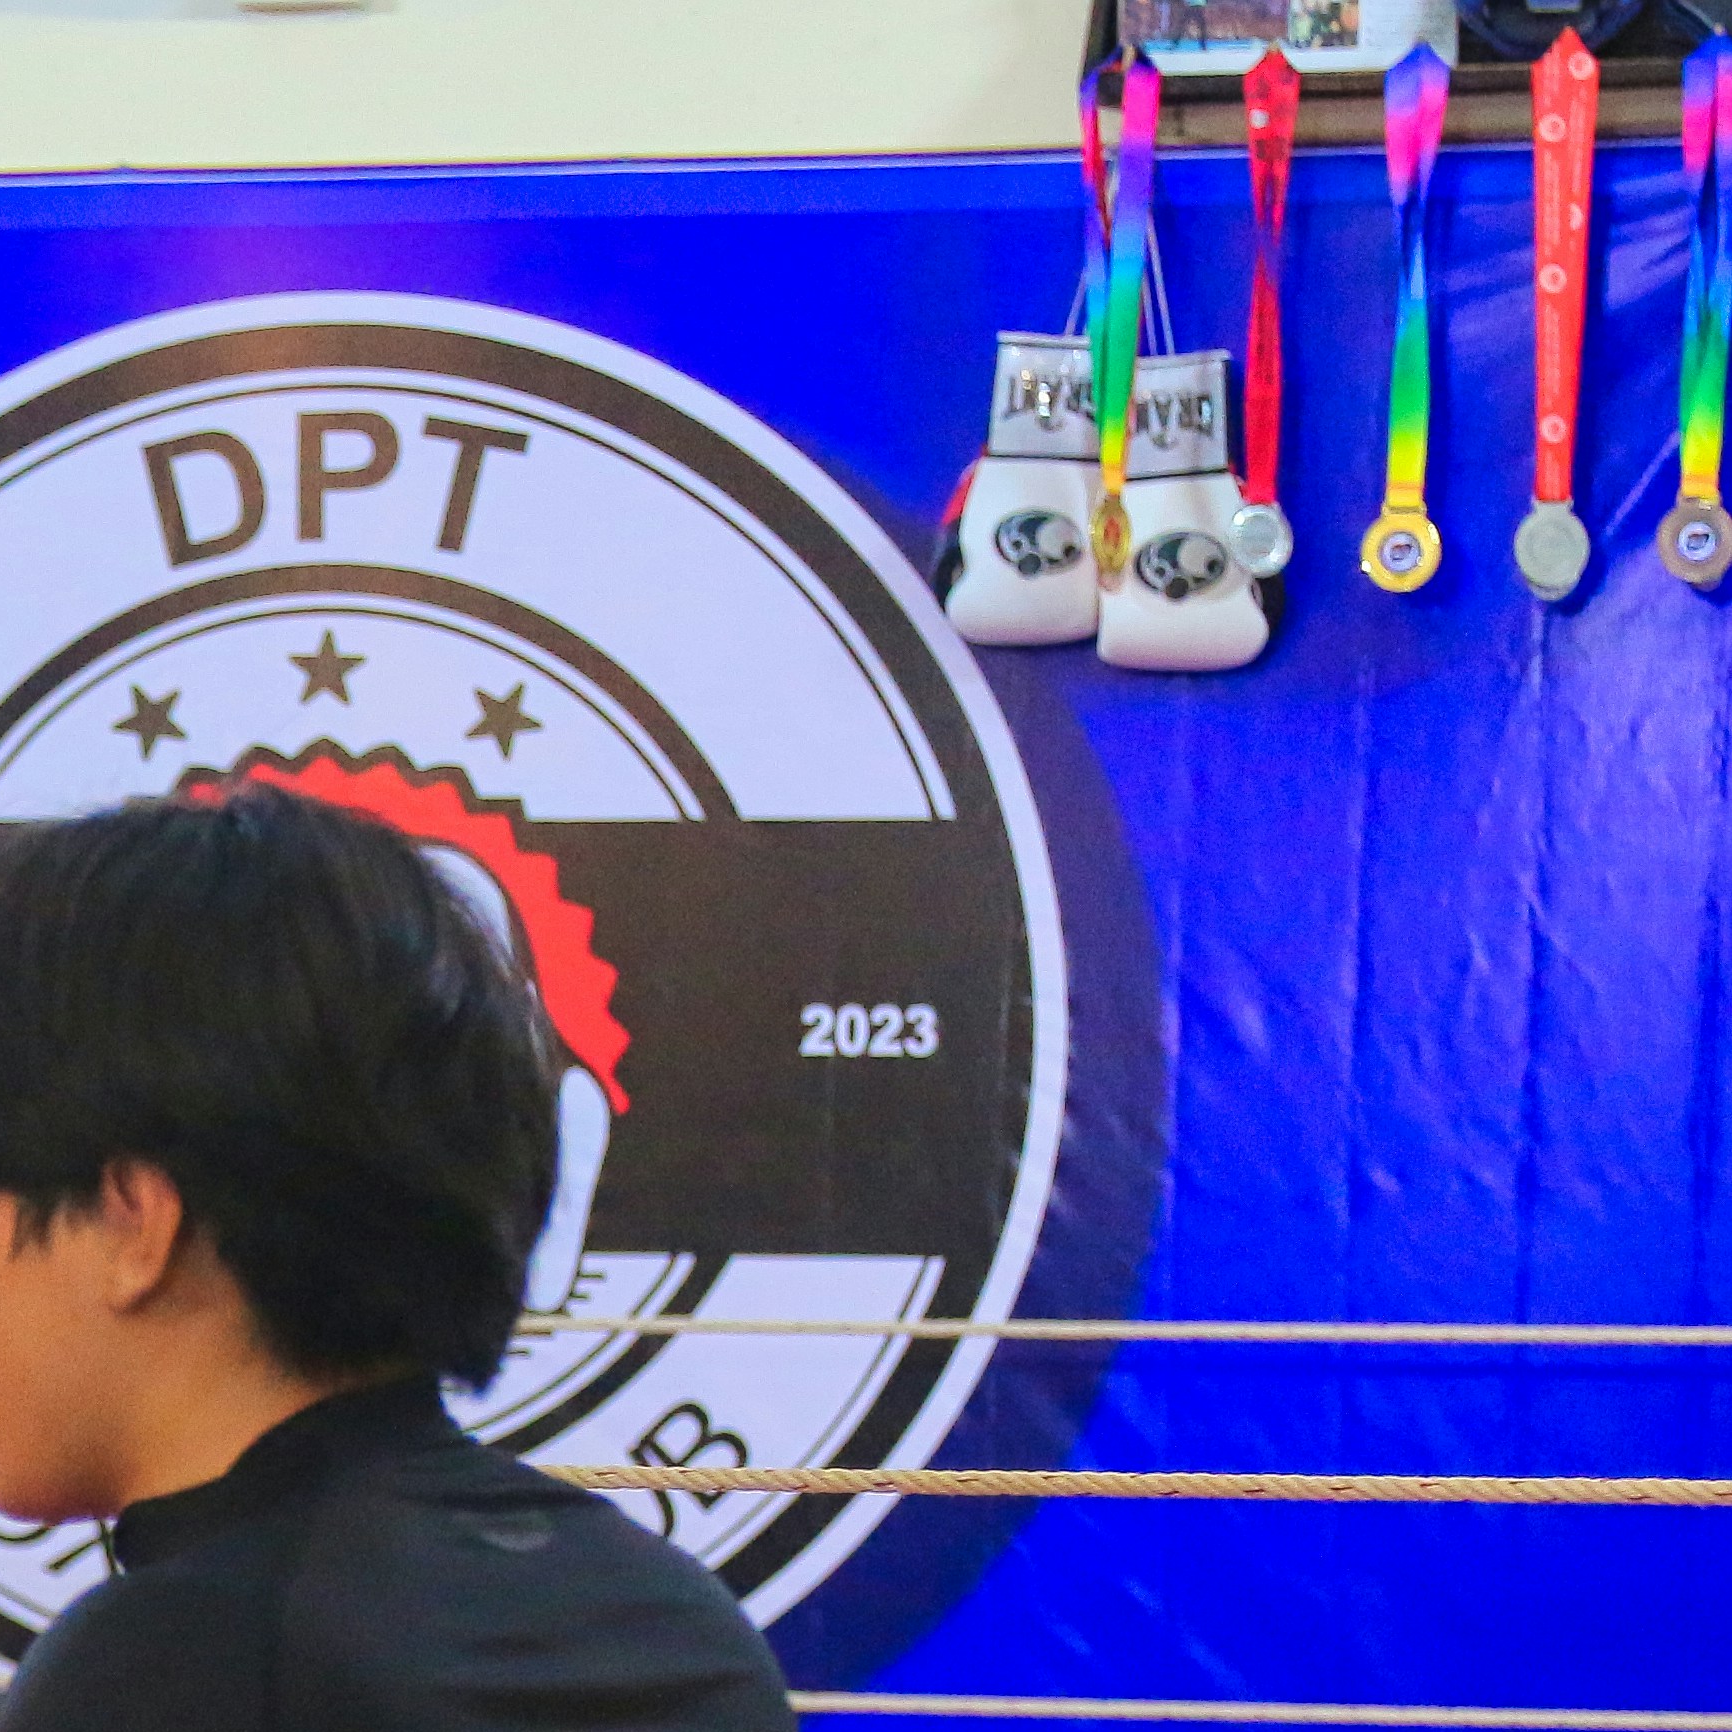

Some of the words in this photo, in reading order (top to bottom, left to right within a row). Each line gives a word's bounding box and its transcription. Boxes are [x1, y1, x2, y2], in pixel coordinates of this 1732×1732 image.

[1133, 392, 1214, 451] GRAN
[143, 410, 528, 567] DPT
[798, 1001, 940, 1058] 2023
